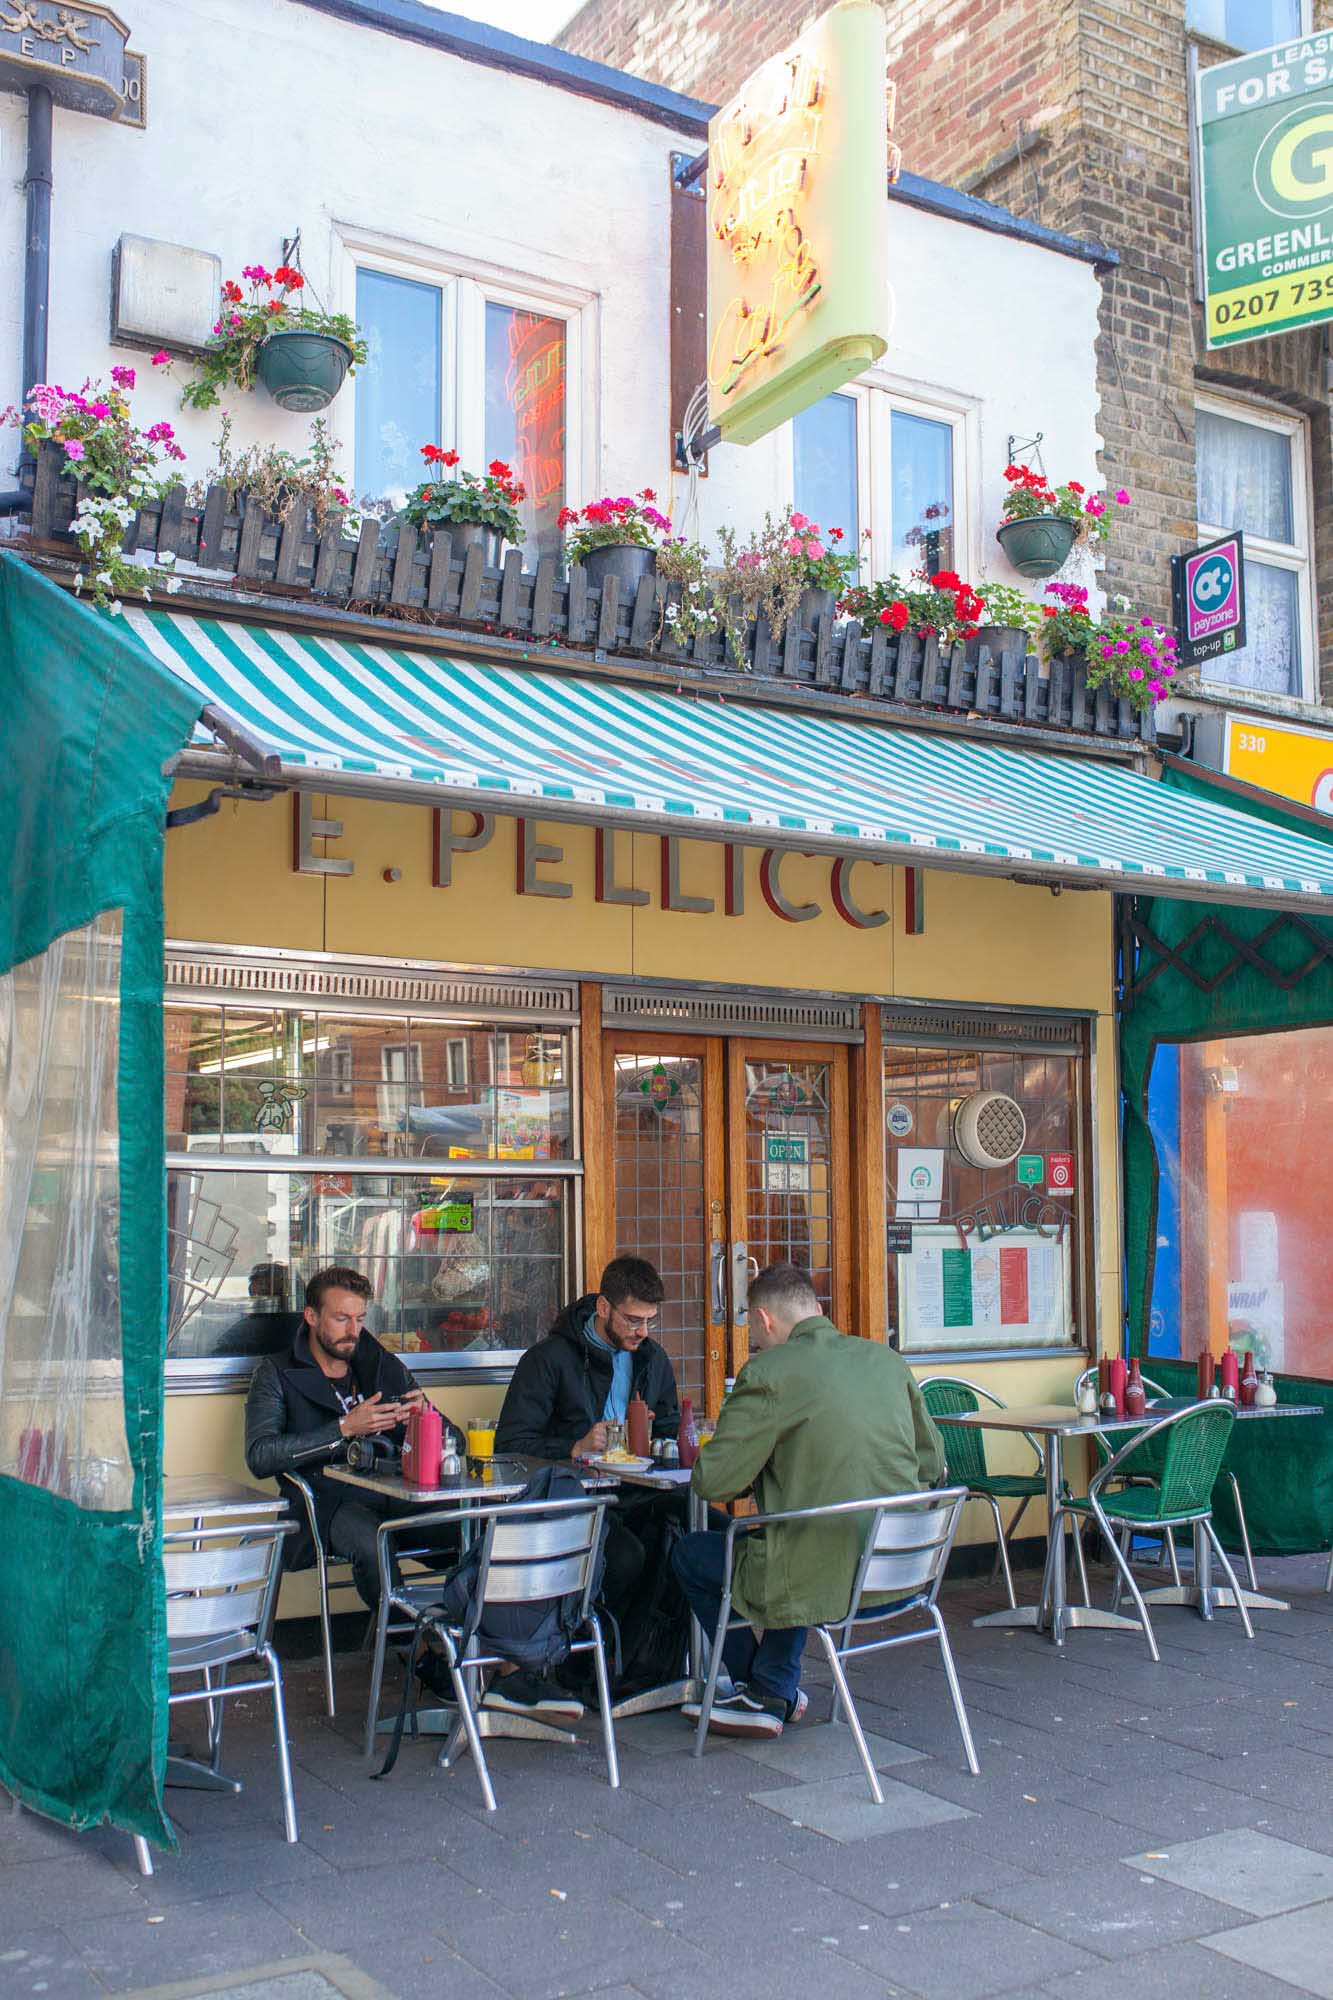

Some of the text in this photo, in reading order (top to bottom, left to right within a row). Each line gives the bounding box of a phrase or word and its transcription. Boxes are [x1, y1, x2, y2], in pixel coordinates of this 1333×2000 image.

[21, 37, 76, 66] E P
[1272, 34, 1333, 69] LEAS
[1216, 57, 1333, 113] FOR S
[1215, 222, 1333, 272] GREENL
[1262, 248, 1333, 277] COMMER
[1215, 290, 1280, 325] 0207
[1193, 607, 1235, 636] payzone
[1193, 639, 1221, 657] top-up
[1239, 733, 1267, 753] 330
[431, 807, 925, 936] PELLICCI
[769, 1144, 801, 1159] OPEN
